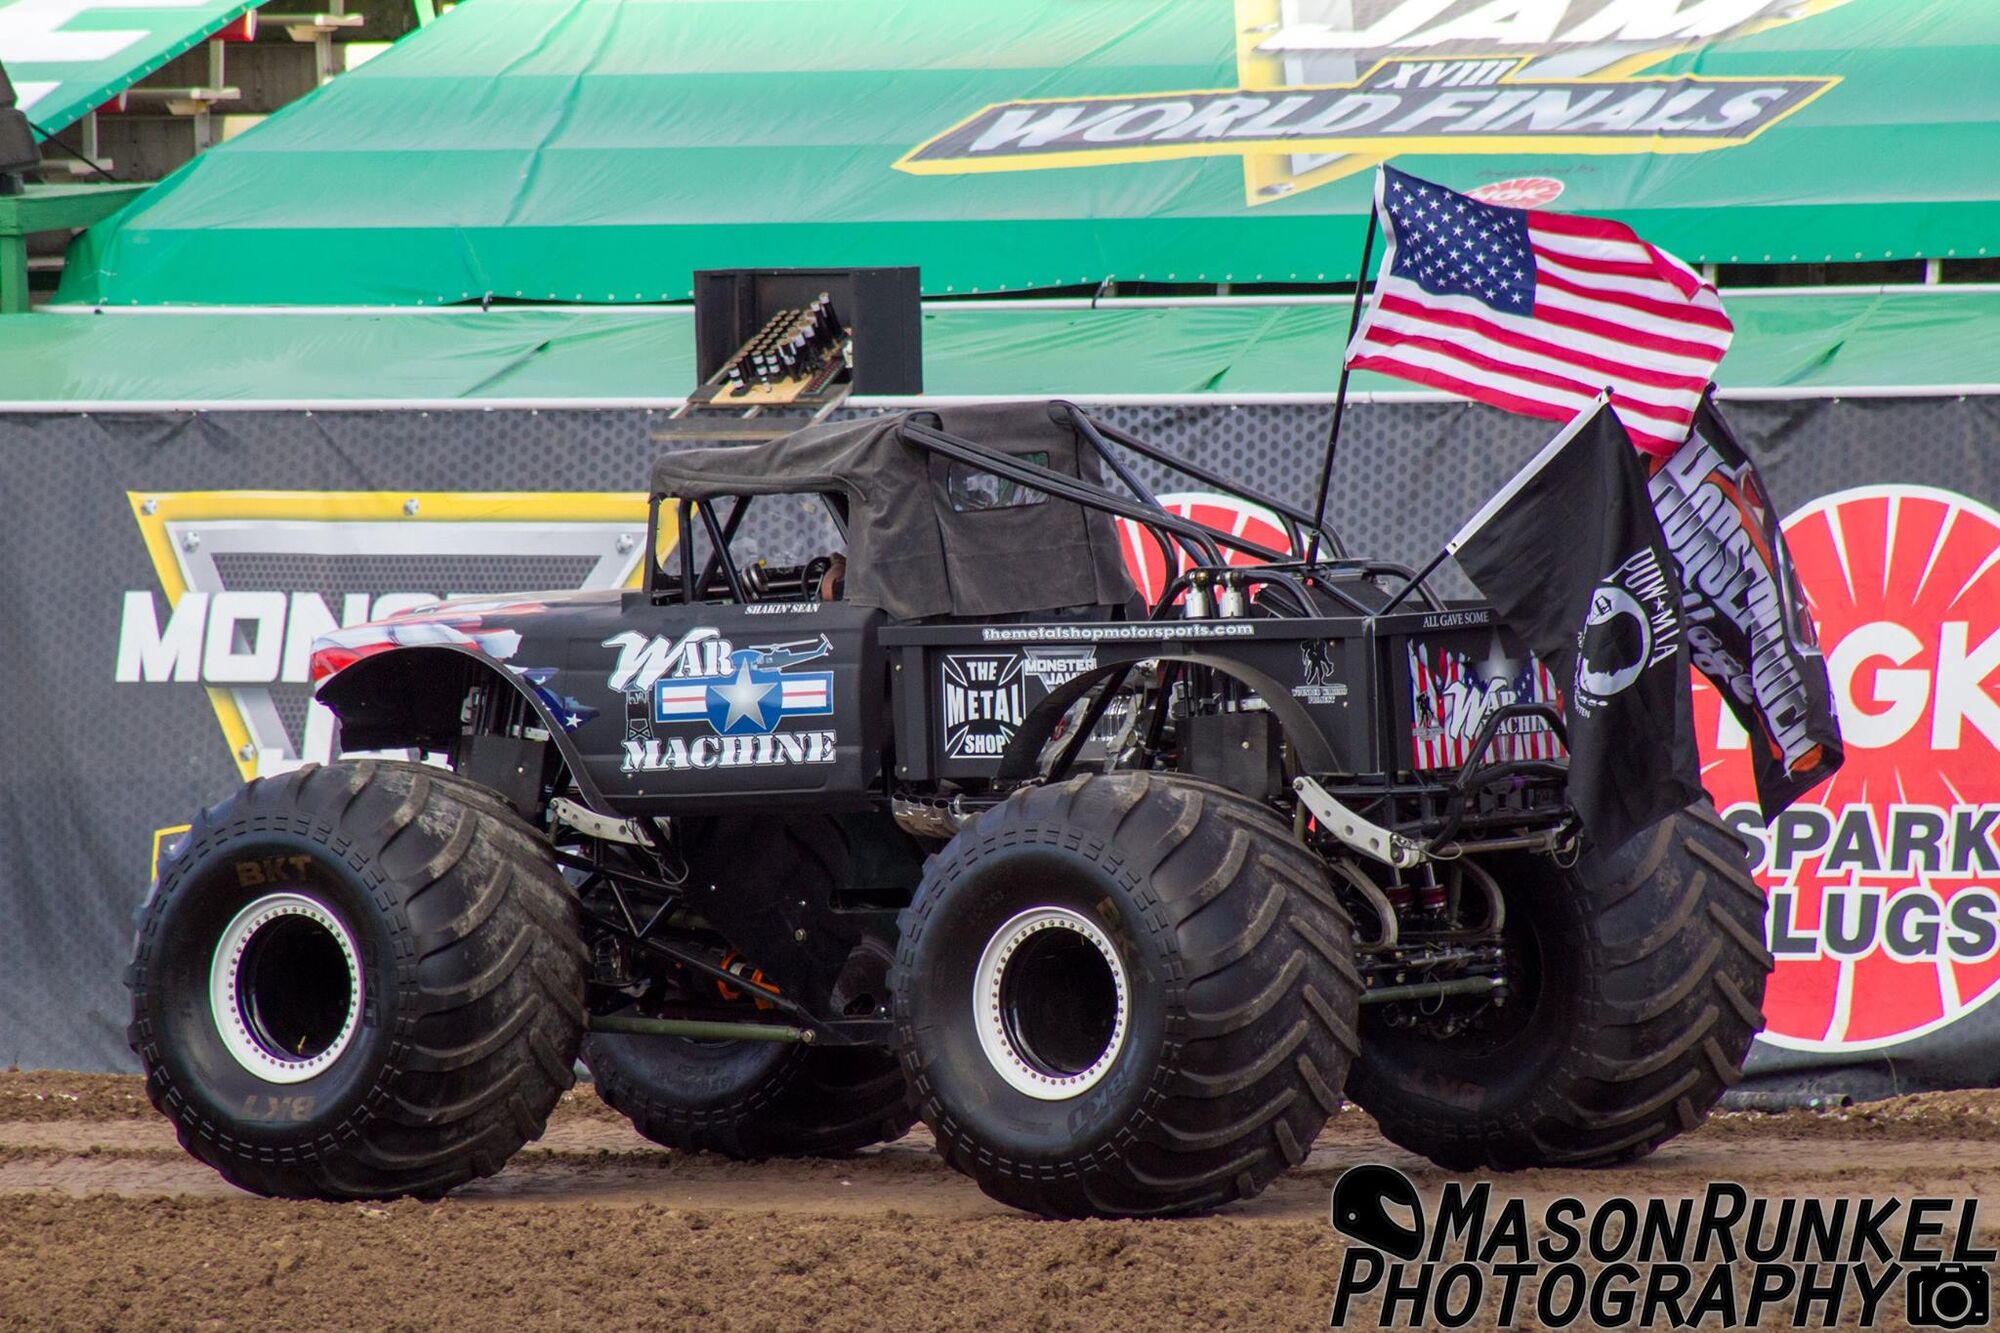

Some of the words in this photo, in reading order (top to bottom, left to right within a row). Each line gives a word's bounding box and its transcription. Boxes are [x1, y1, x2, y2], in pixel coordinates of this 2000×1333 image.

[1373, 60, 1519, 89] XVIII
[969, 94, 1401, 153] WORLD
[1381, 87, 1788, 133] FINALS
[791, 603, 820, 613] SEAN
[1423, 615, 1440, 628] ALL
[1440, 613, 1464, 626] GAVE
[1464, 611, 1489, 624] SOME
[1601, 545, 1669, 602] POW
[1649, 607, 1681, 669] MIA
[982, 623, 1255, 641] themetalshopmotorsports.com
[602, 627, 735, 692] WAR
[966, 661, 998, 681] THE
[1024, 658, 1097, 672] MONSTER
[1714, 620, 2000, 750] GK
[946, 683, 1023, 728] METAL
[621, 730, 837, 772] MACHINE
[965, 734, 1007, 753] SHOP
[1735, 808, 2000, 873] SPARK
[235, 854, 312, 887] BKT
[1771, 892, 1998, 957] LUGS
